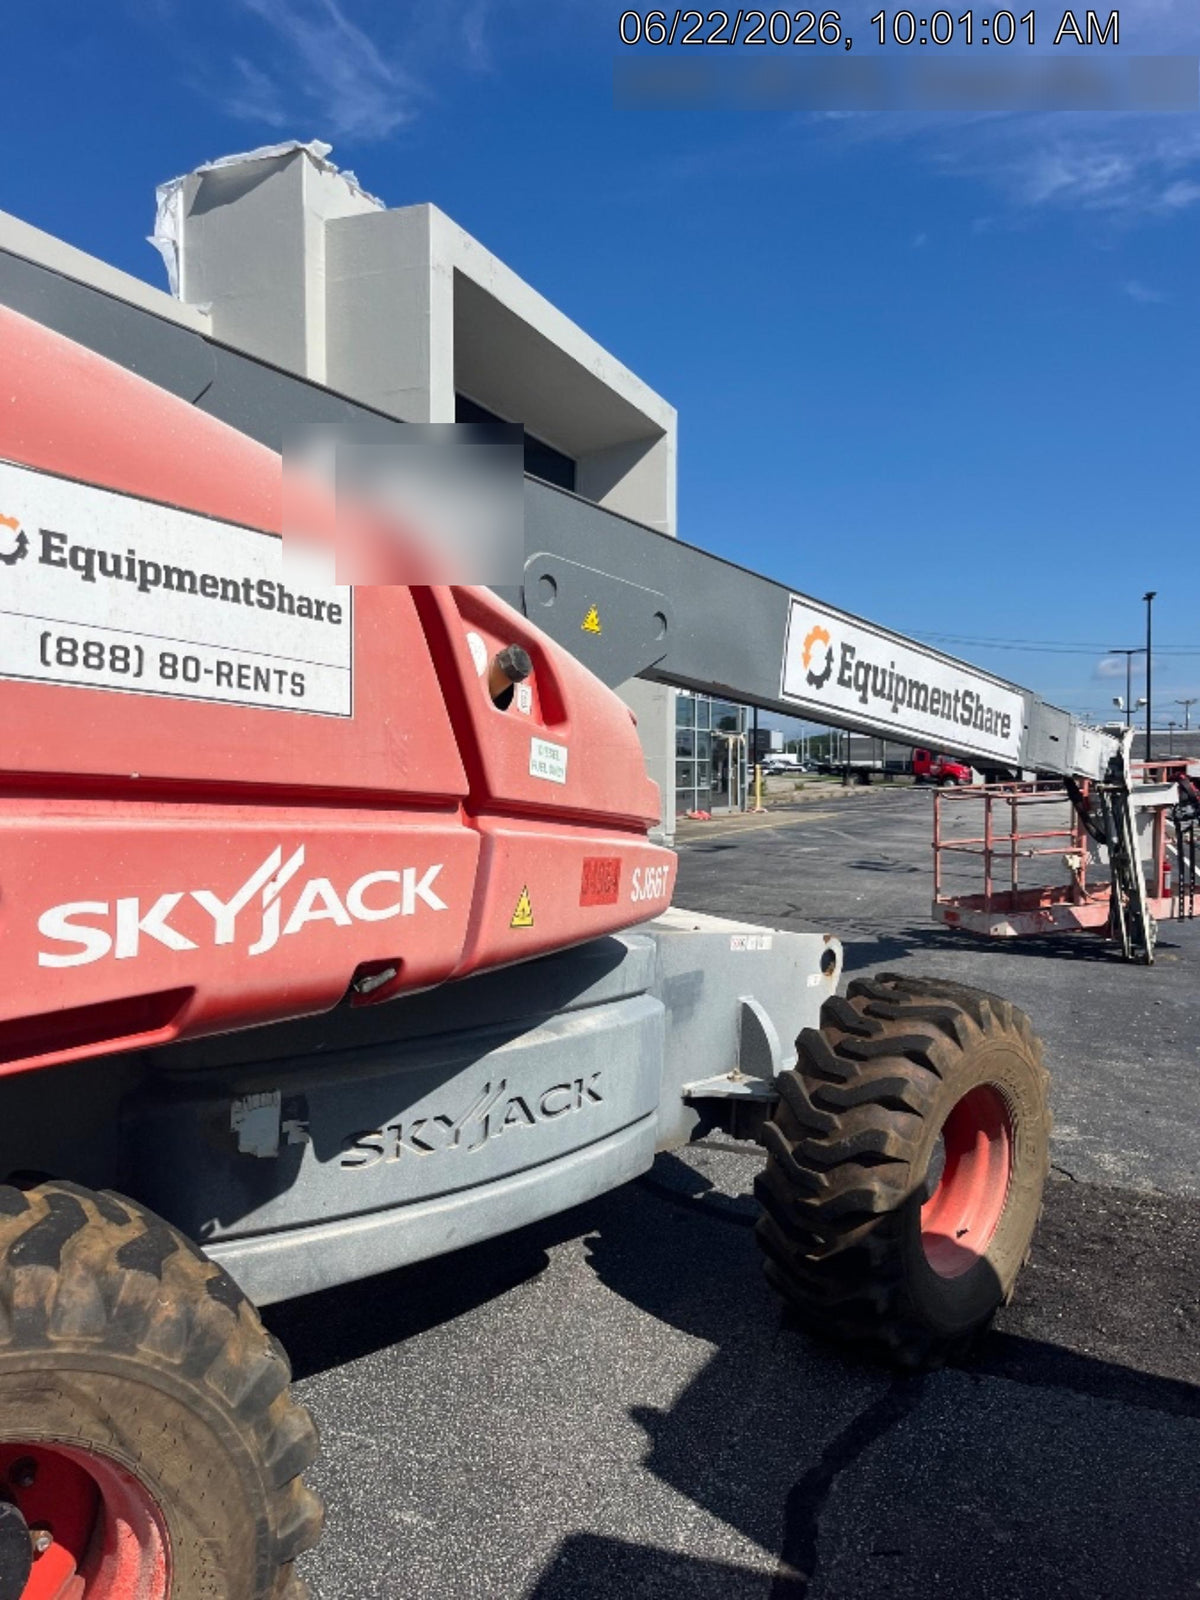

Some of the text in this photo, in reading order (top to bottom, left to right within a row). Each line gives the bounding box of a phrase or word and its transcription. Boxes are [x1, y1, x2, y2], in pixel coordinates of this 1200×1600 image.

[38, 527, 343, 625] EquipmentShare
[39, 631, 306, 698] (888) 80-RENTS
[836, 640, 1012, 740] EquipmentShare
[37, 843, 449, 968] SKYJACK
[340, 1071, 604, 1171] SKYJACK
